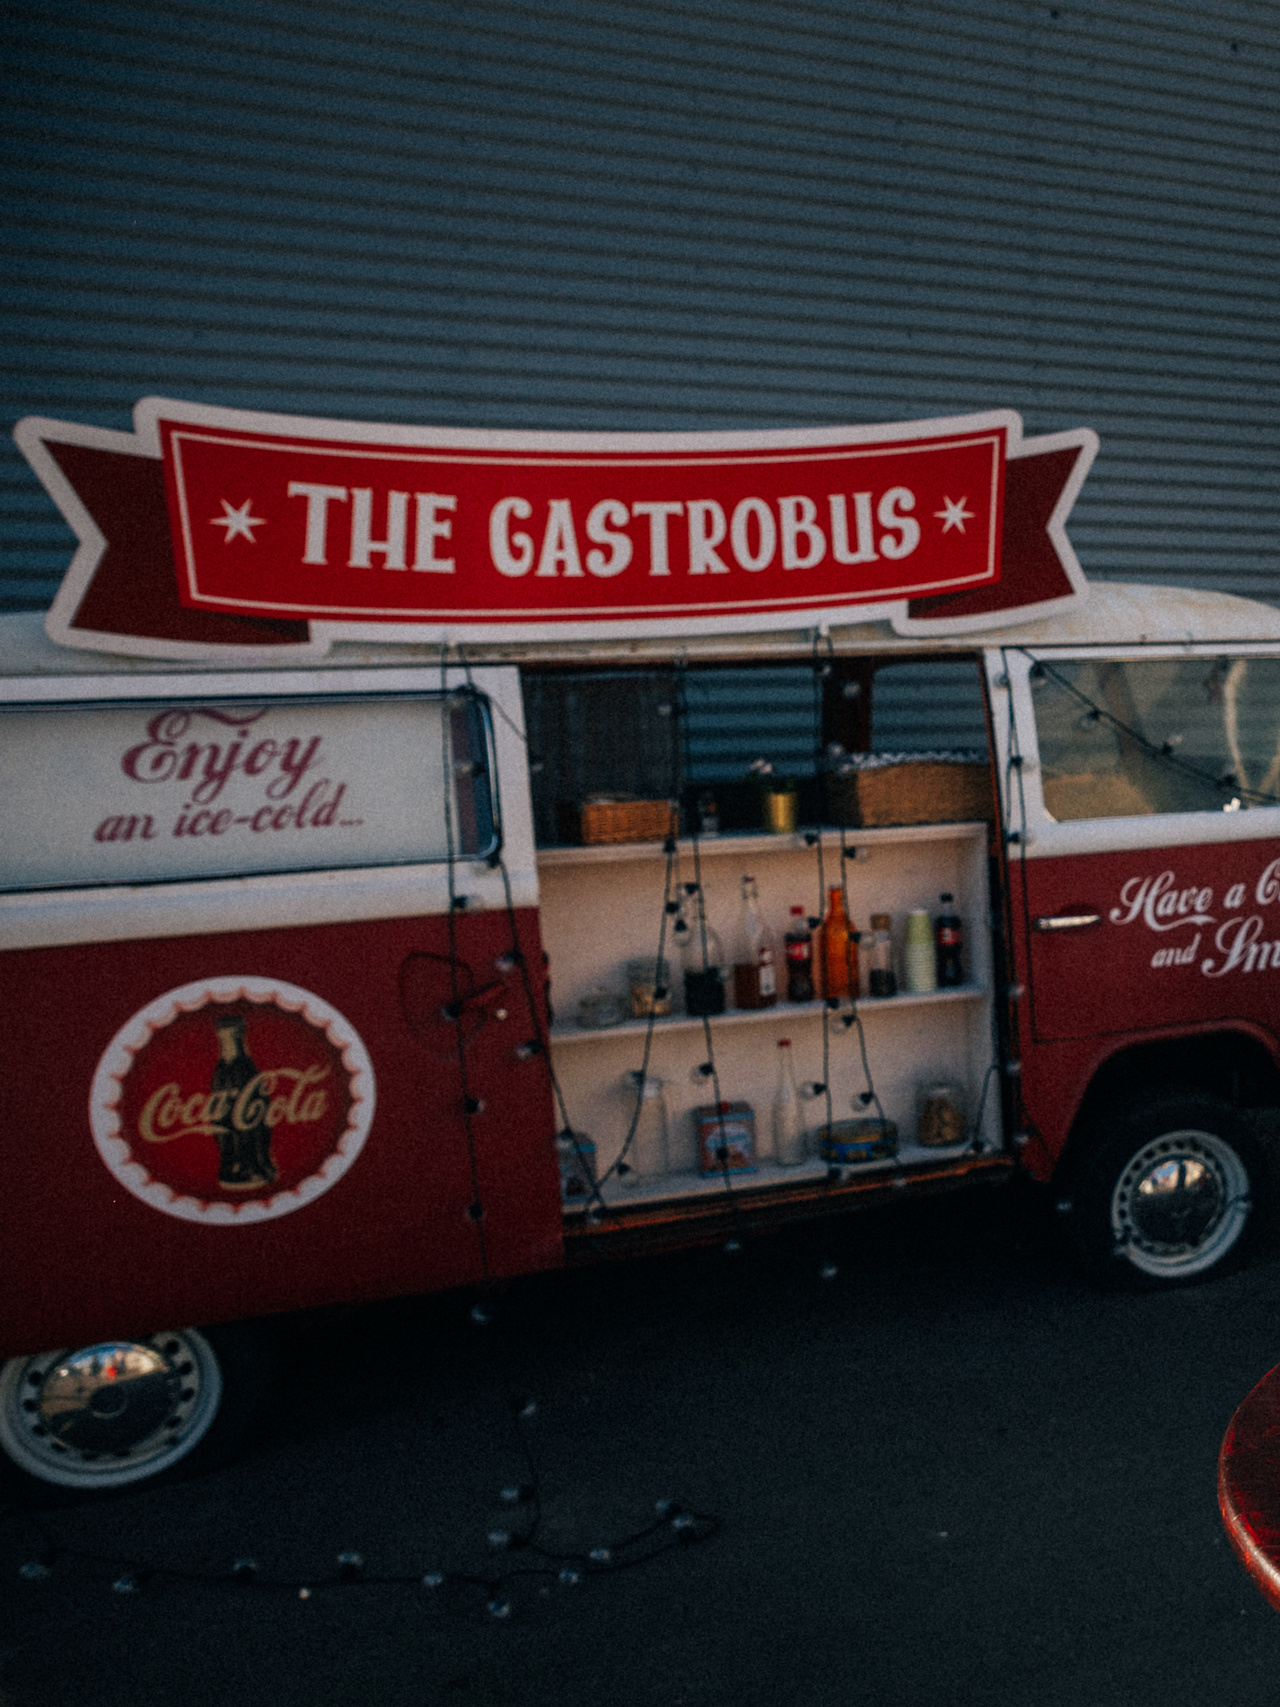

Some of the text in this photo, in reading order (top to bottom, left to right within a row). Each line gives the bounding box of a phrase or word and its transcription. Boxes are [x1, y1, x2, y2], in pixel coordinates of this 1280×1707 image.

[287, 480, 923, 579] THE GASTROBUS
[120, 706, 322, 805] Enjoy
[94, 814, 155, 842] an
[1109, 870, 1217, 932] Have
[1223, 883, 1247, 909] a
[1150, 932, 1201, 968] and
[139, 1064, 332, 1143] Coca-Cola
